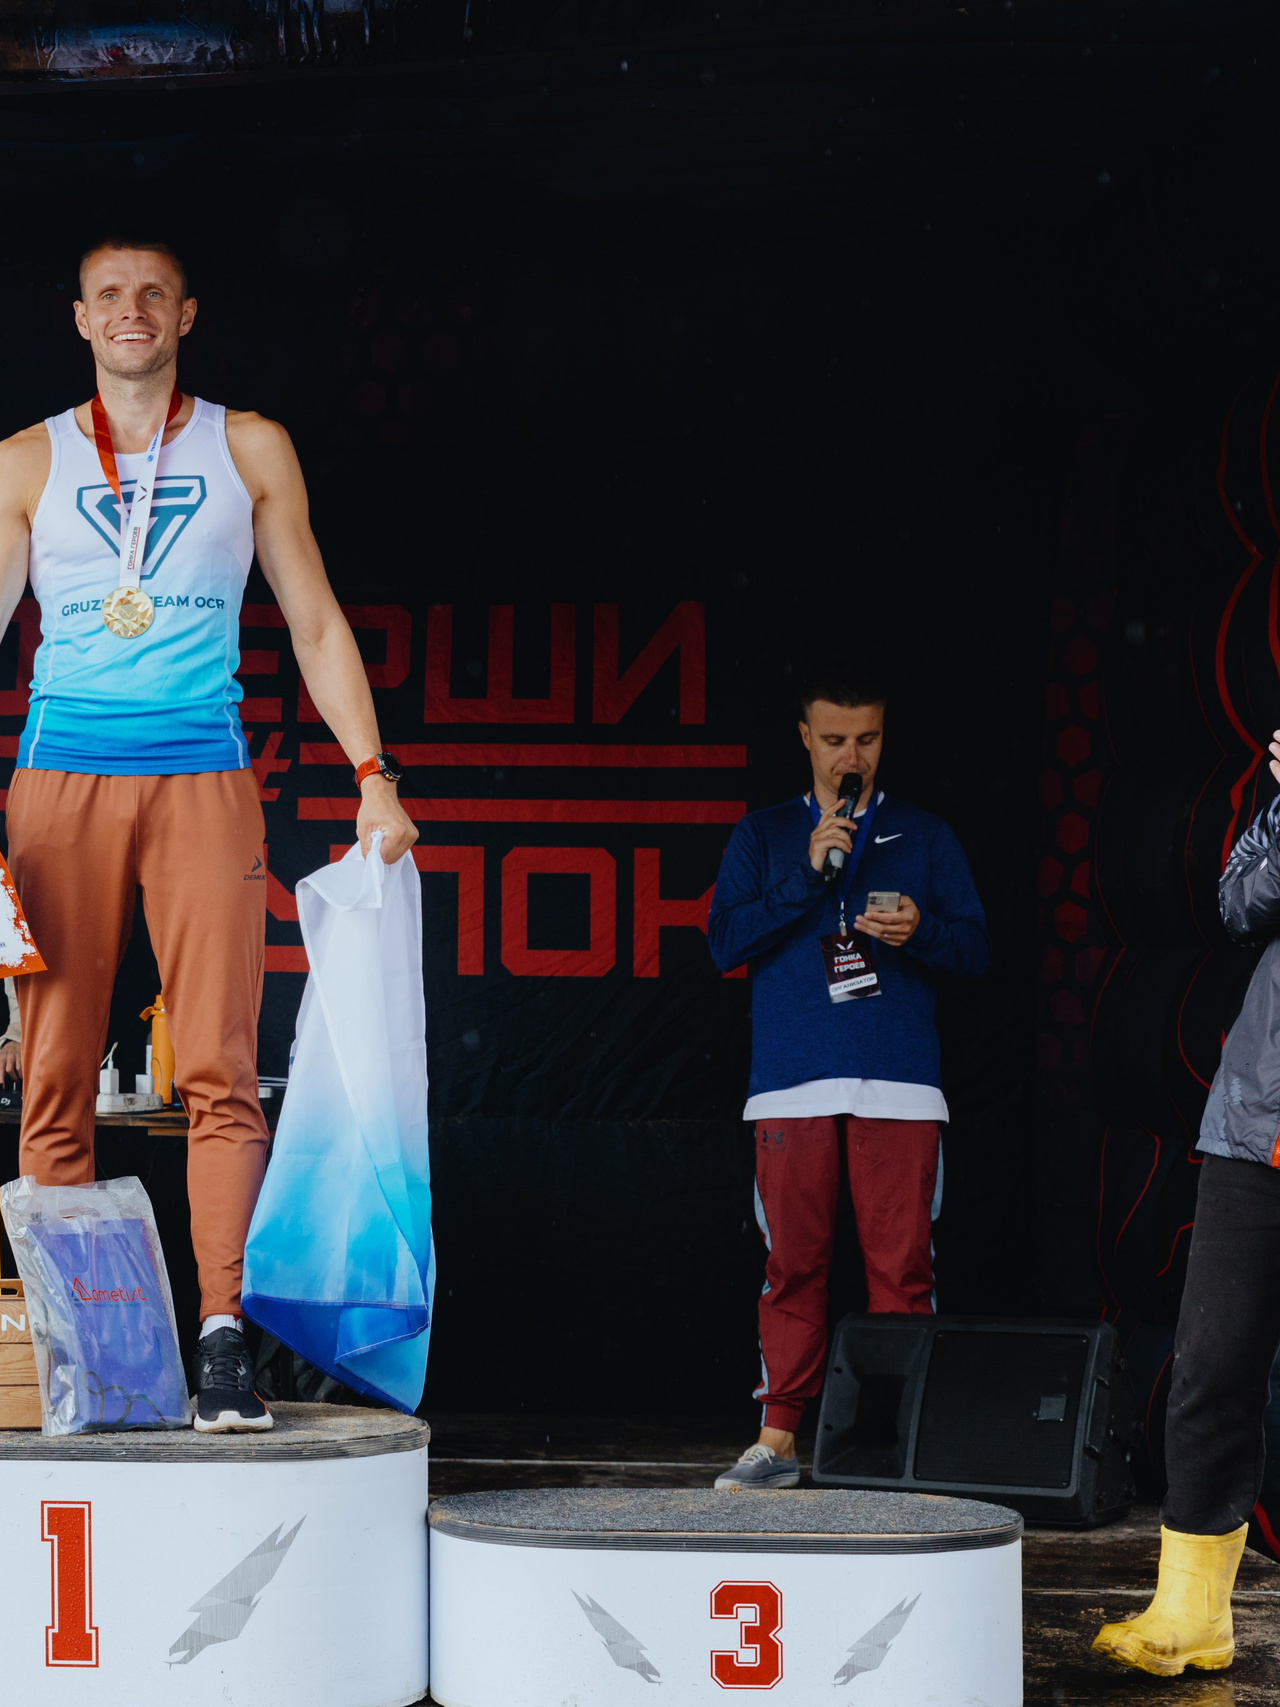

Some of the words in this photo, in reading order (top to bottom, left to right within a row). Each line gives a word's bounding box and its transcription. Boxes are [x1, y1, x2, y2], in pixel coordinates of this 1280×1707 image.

[149, 594, 190, 608] EAM
[194, 596, 225, 610] OCR
[834, 952, 863, 964] ГОНКА
[834, 961, 866, 973] ГЕРОЕВ
[40, 1500, 100, 1668] 1
[710, 1580, 783, 1690] 3
